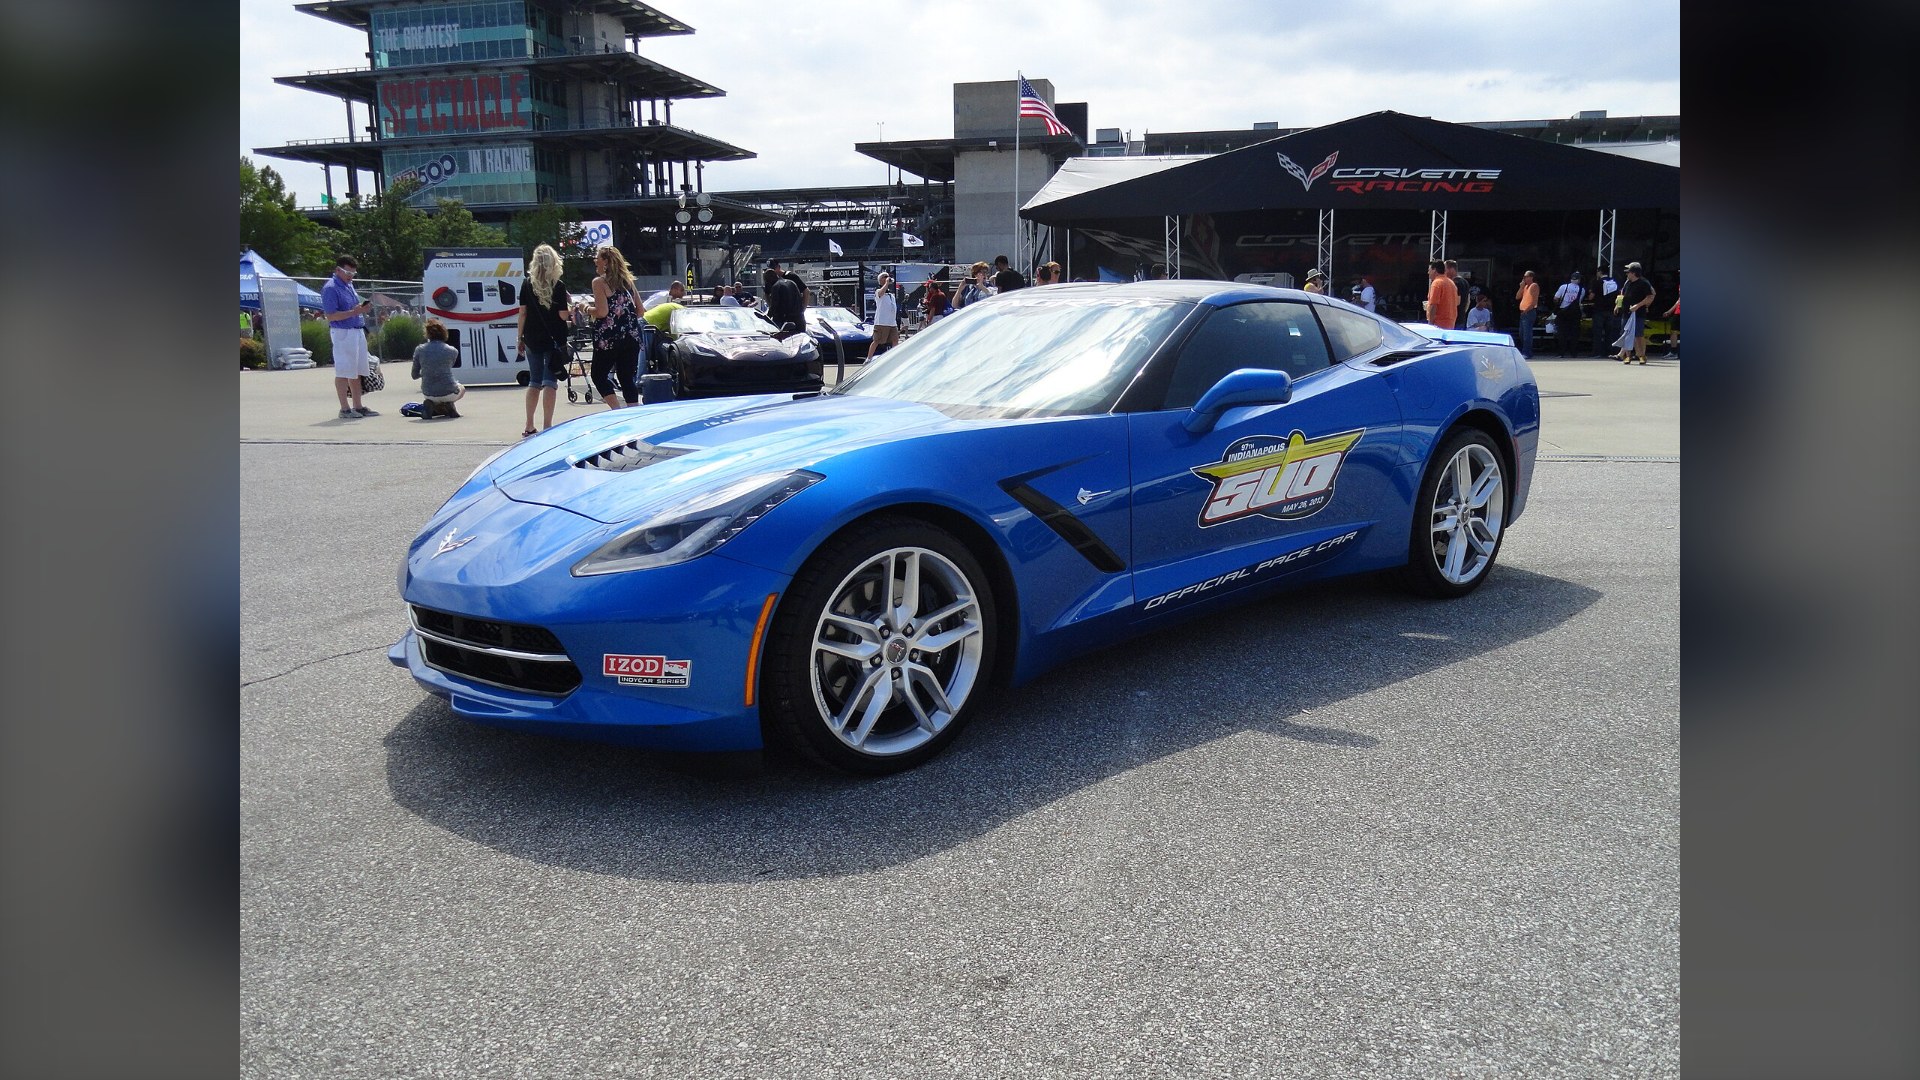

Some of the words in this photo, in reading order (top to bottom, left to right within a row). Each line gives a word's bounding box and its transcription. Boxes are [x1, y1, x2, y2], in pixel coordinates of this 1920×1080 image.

[378, 28, 400, 51] THE
[403, 23, 460, 50] GREATEST
[382, 74, 528, 133] SPECTACLE
[468, 149, 482, 174] IN
[486, 147, 531, 173] RACING
[1332, 167, 1503, 179] CORVETTE
[1329, 180, 1495, 195] RACING
[1228, 442, 1286, 462] INDIANAPOLIS
[1241, 443, 1255, 451] 97TH
[1204, 452, 1343, 520] 500
[1281, 502, 1299, 513] MAY
[1309, 496, 1324, 506] 2013
[1144, 568, 1250, 610] OFFICIAL
[1255, 546, 1314, 573] PACE
[1316, 530, 1358, 552] CAR
[608, 657, 660, 673] IZOD
[621, 676, 654, 684] INDYCAR
